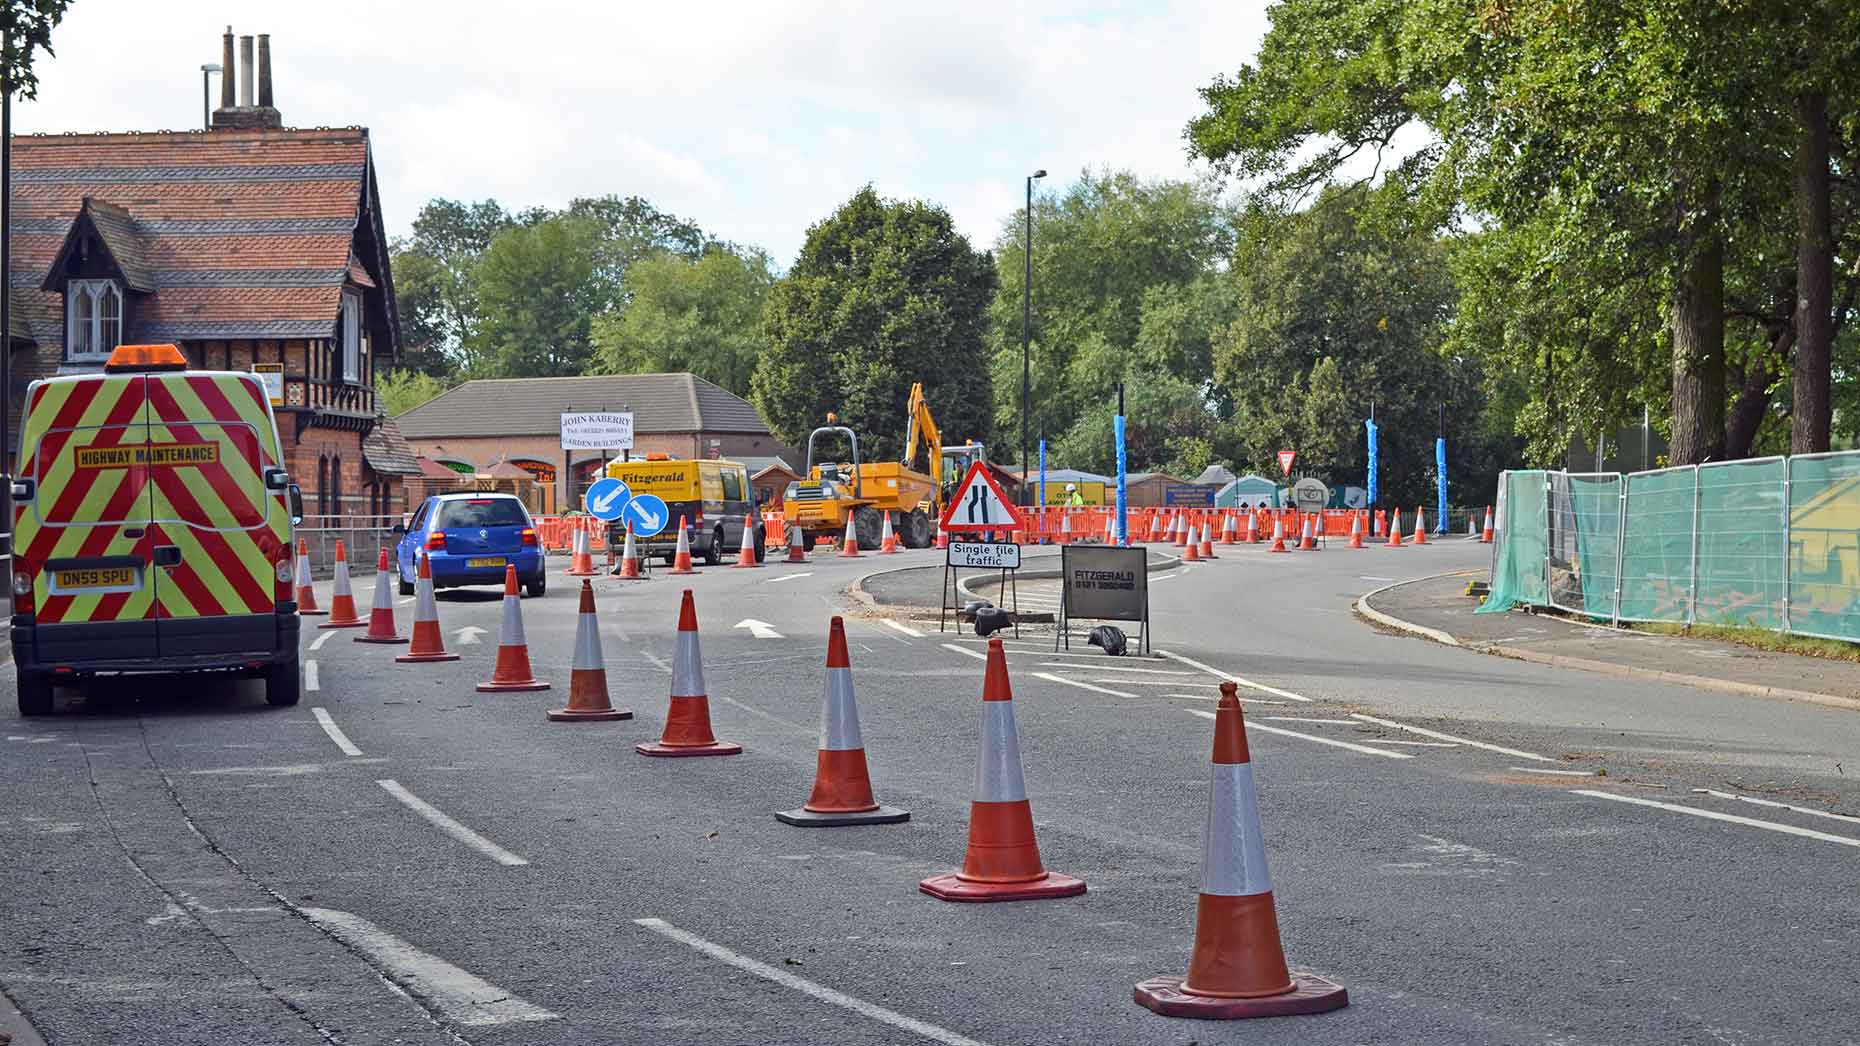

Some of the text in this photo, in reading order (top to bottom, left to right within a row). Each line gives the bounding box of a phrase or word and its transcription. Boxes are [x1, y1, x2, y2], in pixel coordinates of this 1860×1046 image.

[562, 415, 631, 426] JOHN KABERRY
[562, 437, 632, 448] GARDEN BUILDINGS
[81, 447, 214, 465] HIGHWAY MAINTENANCE
[622, 472, 684, 484] Fitzgerald
[954, 543, 1014, 557] Single file
[966, 554, 1002, 565] traffic
[63, 570, 129, 585] DN59 SPU
[1074, 570, 1135, 581] FITZGERALD
